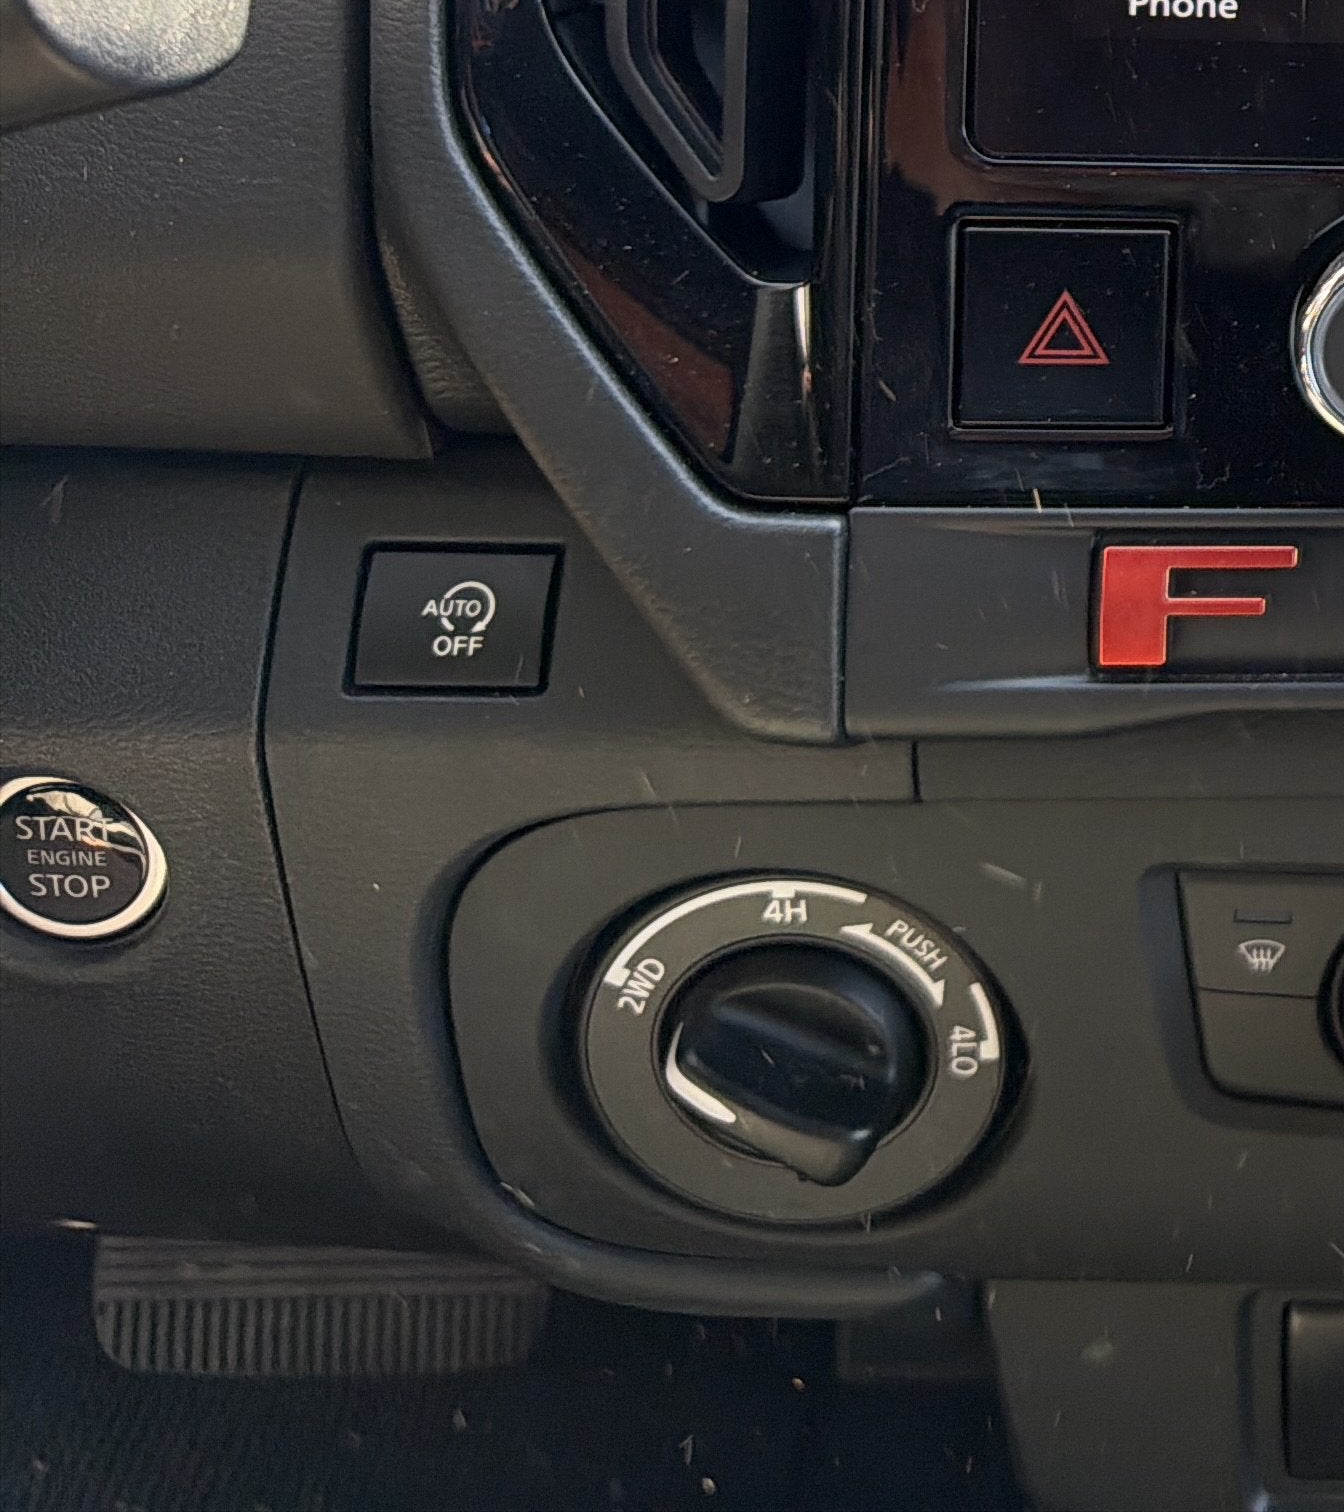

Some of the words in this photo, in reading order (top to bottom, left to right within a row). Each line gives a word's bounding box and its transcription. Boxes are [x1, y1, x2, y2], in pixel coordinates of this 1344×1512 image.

[421, 598, 483, 619] AUTO
[432, 635, 484, 657] OFF
[15, 815, 114, 842] START
[27, 848, 108, 867] ENGINE
[28, 873, 111, 898] STOP
[762, 899, 808, 925] 4H
[885, 919, 948, 971] PUSH
[617, 957, 666, 1015] 2WD
[948, 1024, 979, 1079] 4LO
